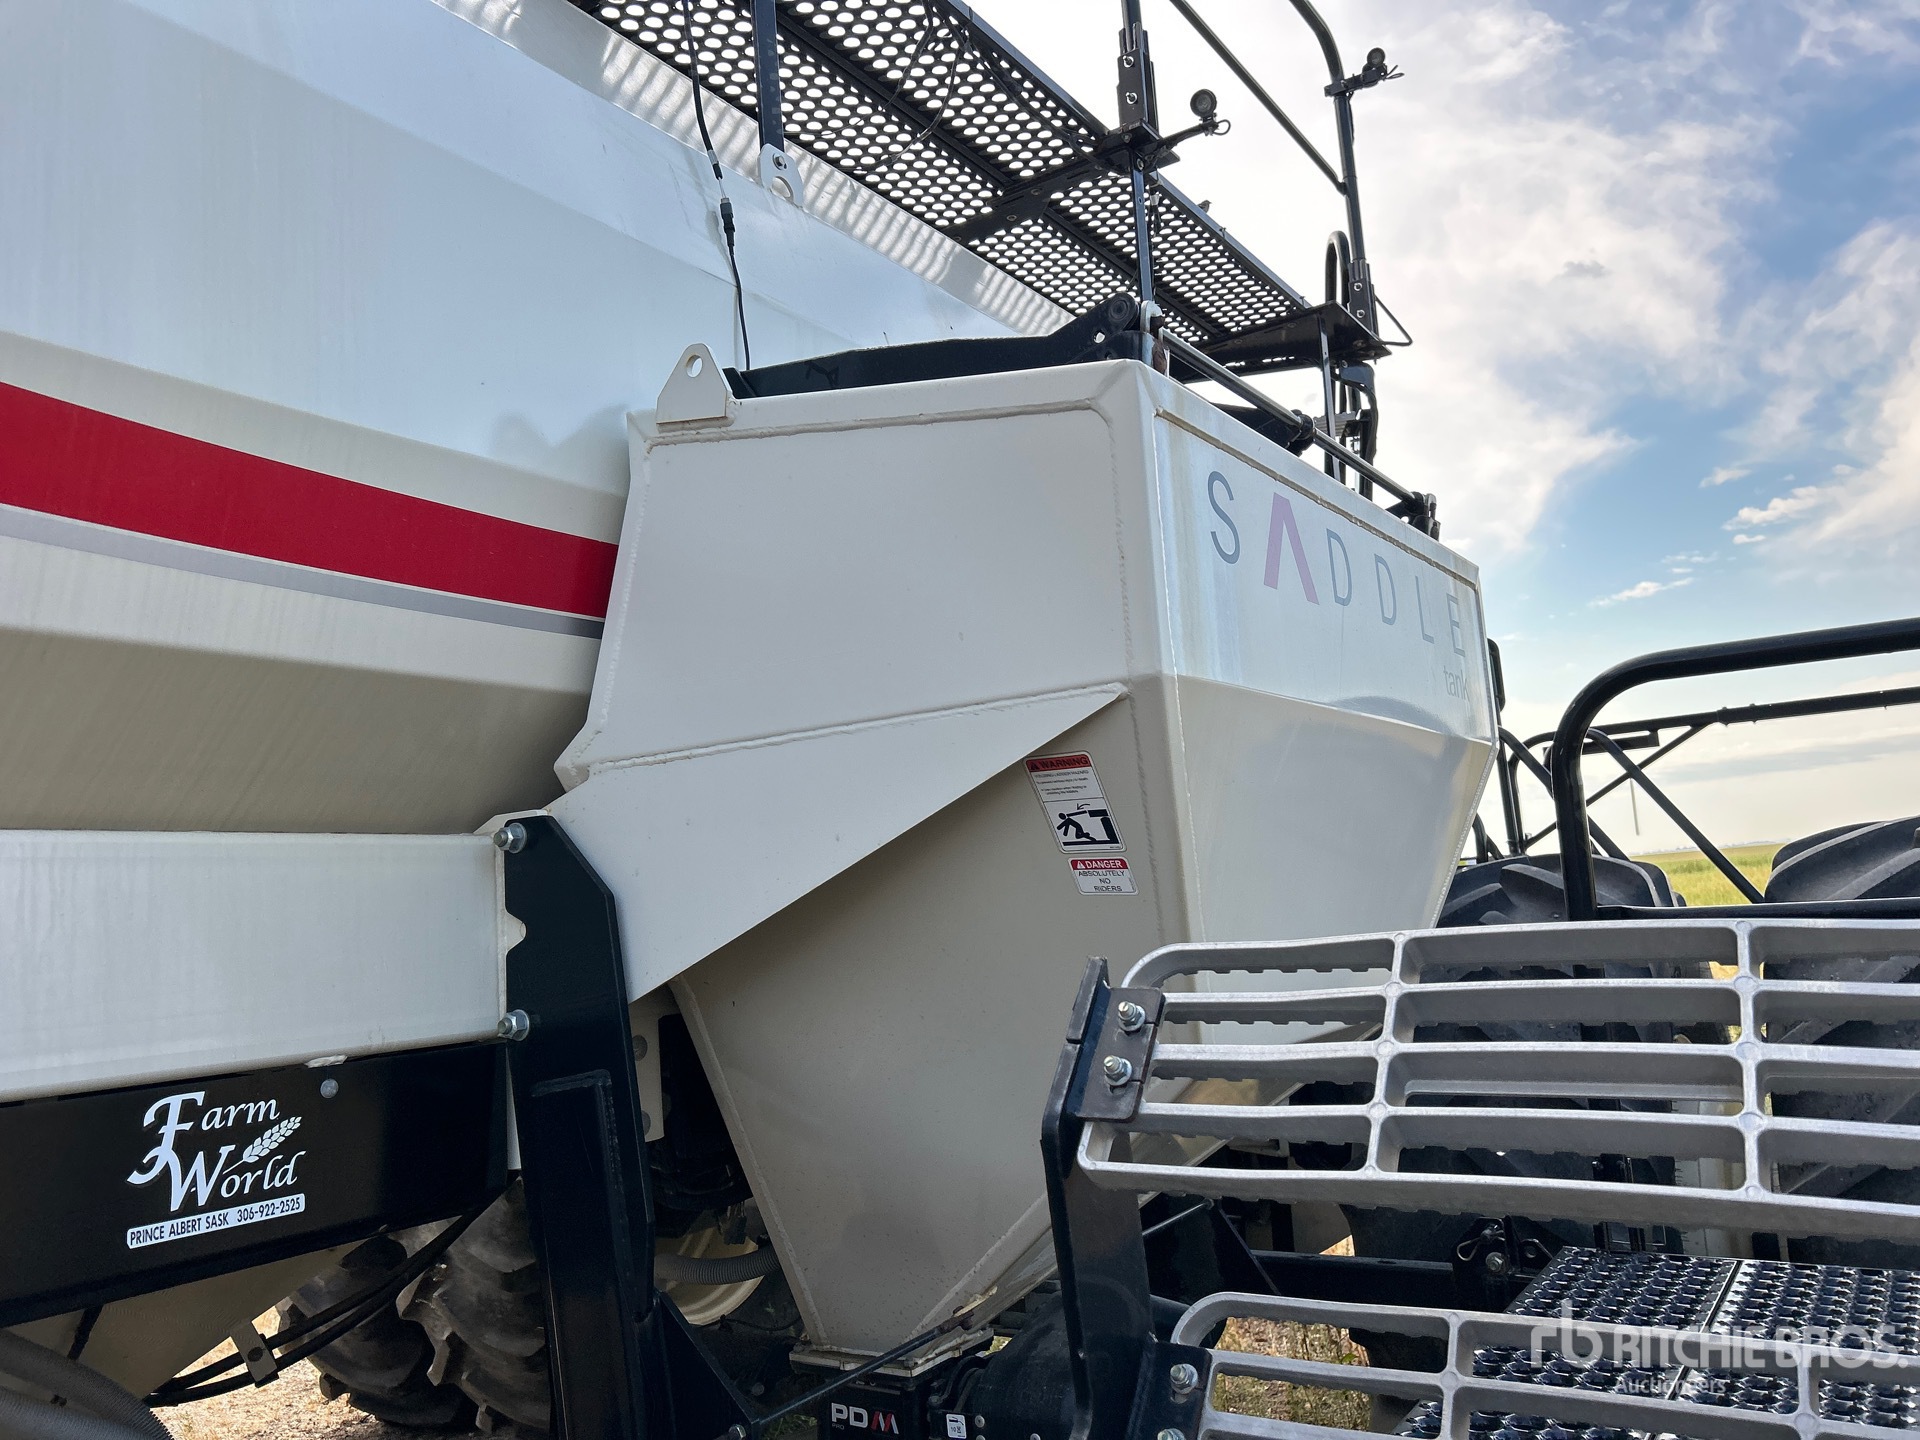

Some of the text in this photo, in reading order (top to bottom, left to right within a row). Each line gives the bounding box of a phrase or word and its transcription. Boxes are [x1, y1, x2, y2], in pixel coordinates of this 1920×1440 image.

[1207, 470, 1465, 658] SADDLE
[1443, 665, 1470, 702] tank
[1039, 756, 1089, 769] WARNING
[1085, 860, 1123, 869] DANGER
[143, 1091, 280, 1151] Farm
[127, 1144, 306, 1212] World
[130, 1197, 301, 1246] PRINCE ALBERT SASK 306-922-2525
[831, 1402, 899, 1435] PDM
[831, 1422, 845, 1431] PRO
